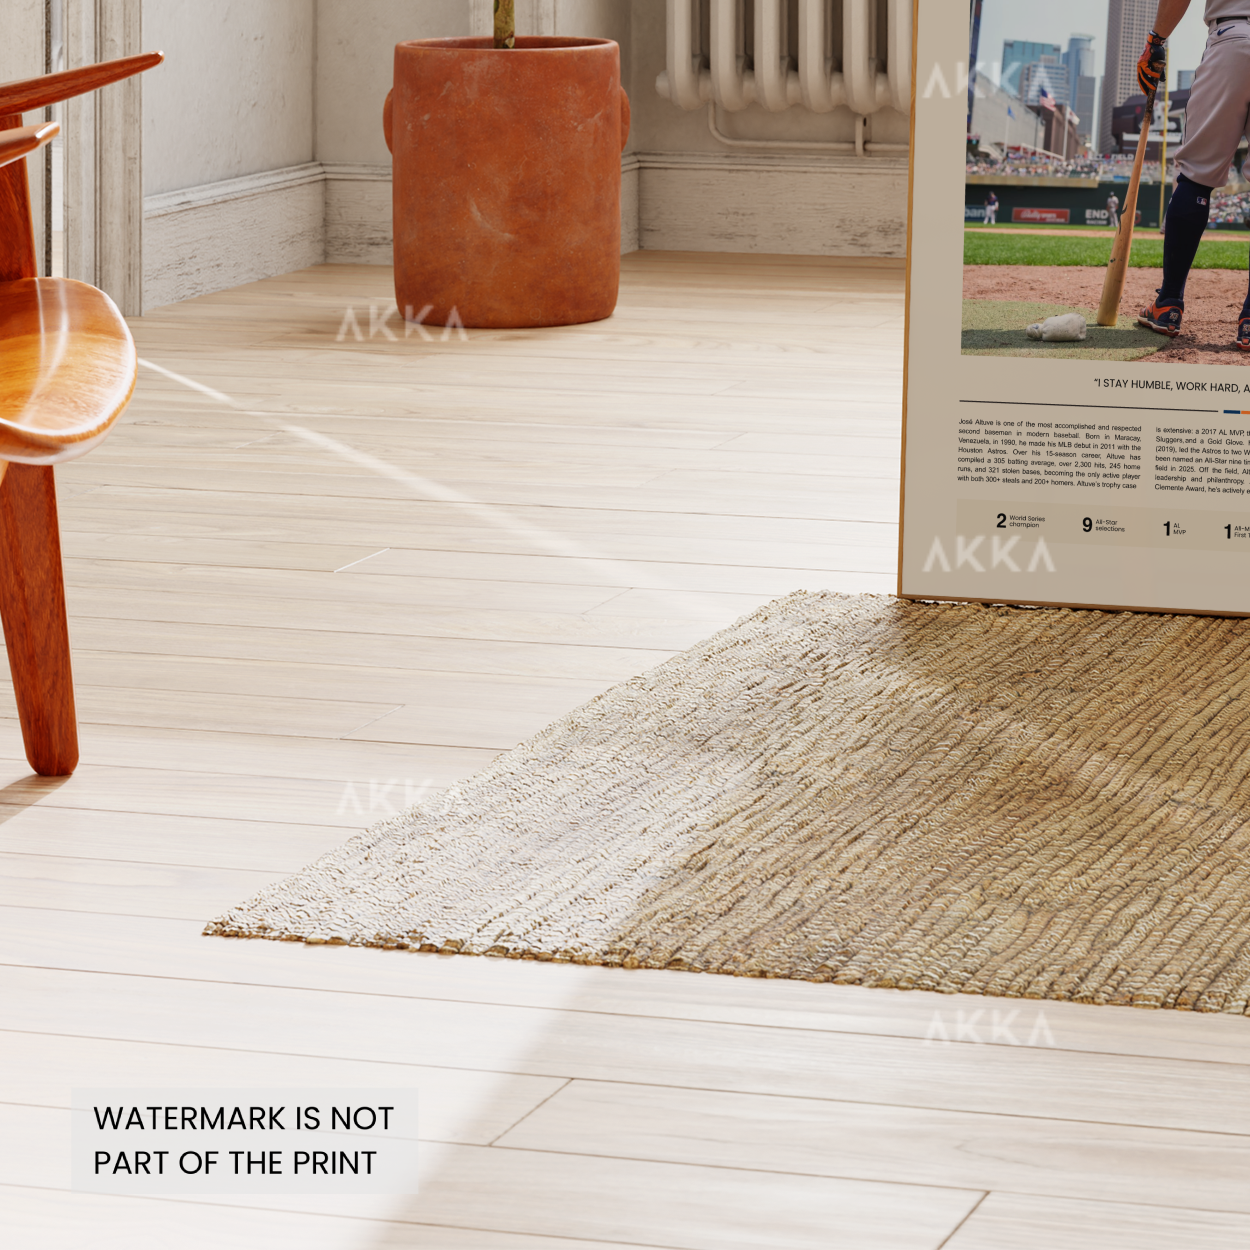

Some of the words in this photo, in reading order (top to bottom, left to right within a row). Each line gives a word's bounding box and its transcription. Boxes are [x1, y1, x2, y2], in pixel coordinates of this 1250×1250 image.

[1085, 209, 1109, 219] END
[1103, 378, 1129, 388] STAY
[1131, 379, 1174, 392] HUMBLE,
[1175, 381, 1208, 392] WORK
[1210, 382, 1241, 394] HARD,
[974, 418, 994, 426] Altuve
[1054, 422, 1096, 431] accomplished
[1112, 424, 1142, 433] respected
[1230, 429, 1245, 437] MVP,
[1026, 430, 1050, 438] modern
[1086, 432, 1100, 440] Born
[1114, 434, 1141, 443] Maracay,
[996, 513, 1007, 528] 2
[1009, 521, 1039, 529] champion
[1082, 517, 1093, 532] 9
[1163, 521, 1170, 536] 1
[1224, 524, 1231, 539] 1
